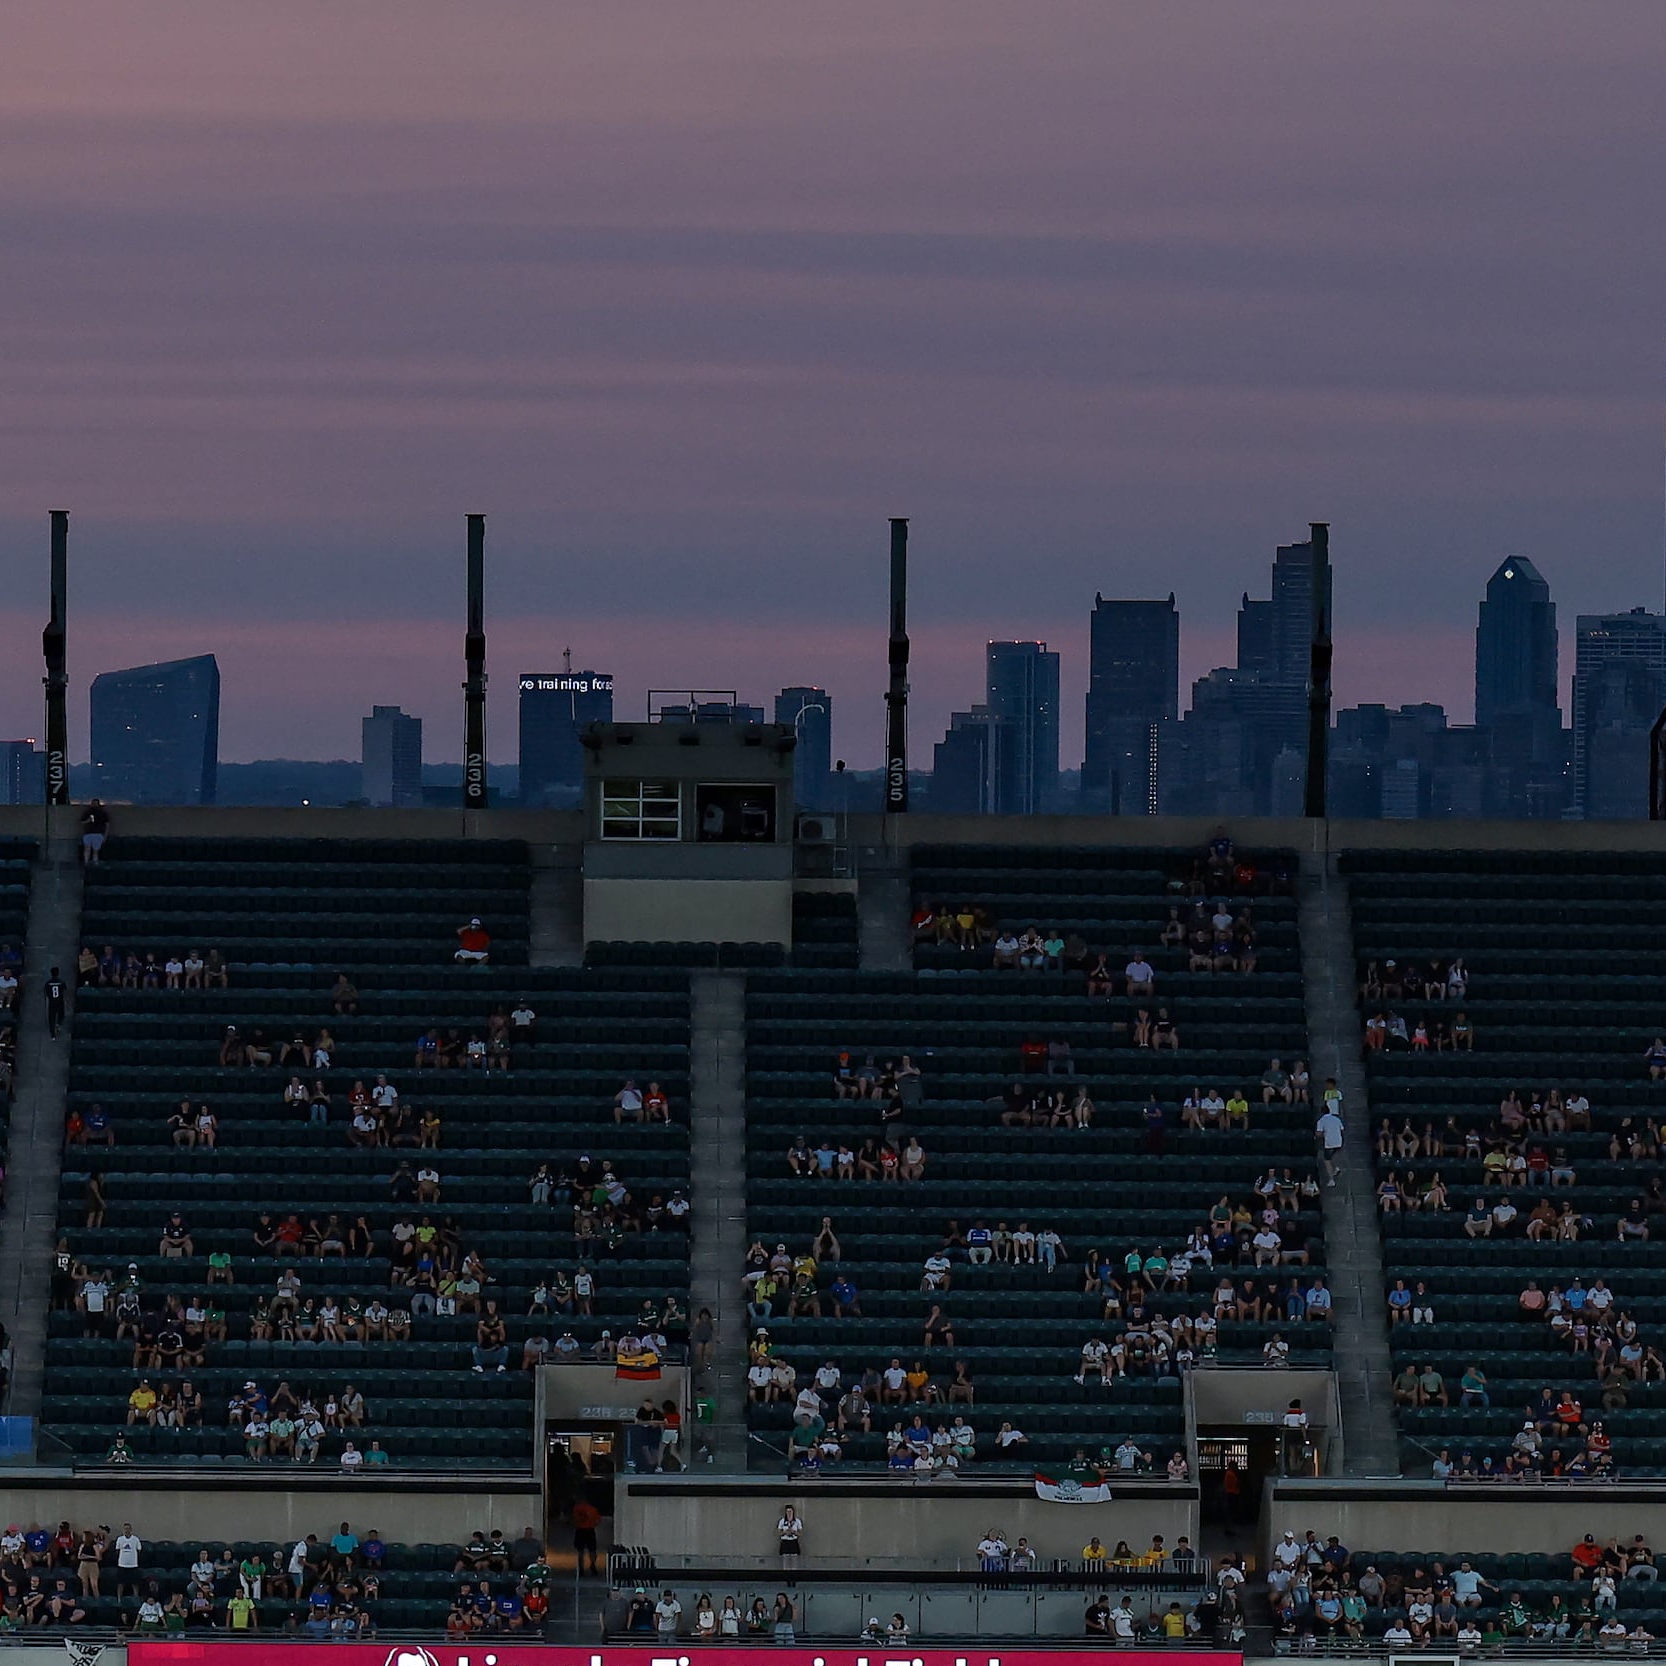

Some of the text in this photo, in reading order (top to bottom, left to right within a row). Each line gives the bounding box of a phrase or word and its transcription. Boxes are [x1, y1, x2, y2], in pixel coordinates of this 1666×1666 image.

[537, 678, 588, 692] training
[49, 750, 64, 795] 237
[468, 753, 482, 797] 236
[889, 757, 904, 802] 235
